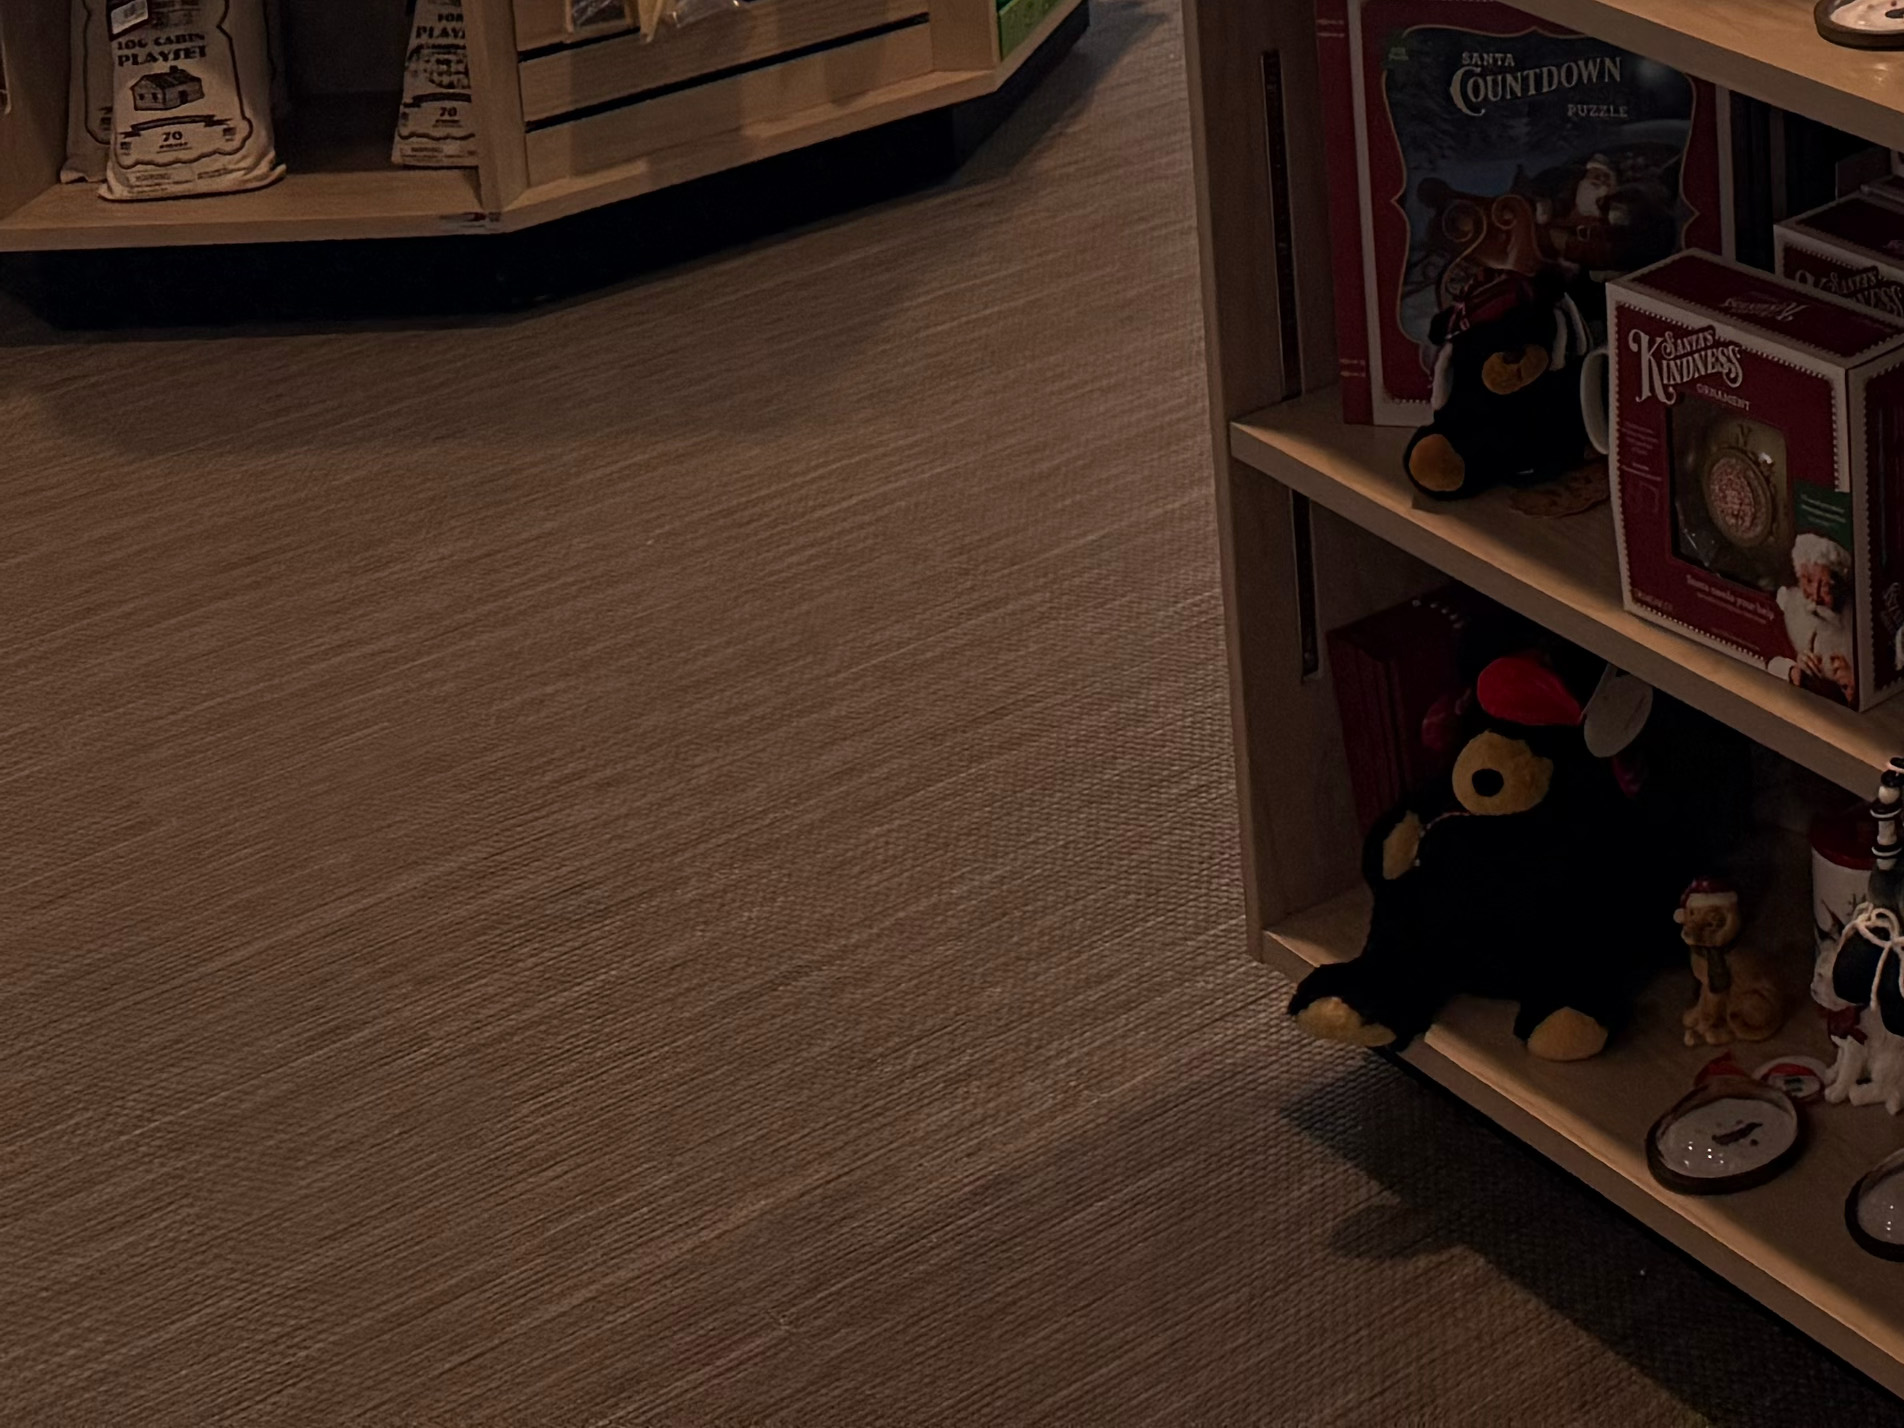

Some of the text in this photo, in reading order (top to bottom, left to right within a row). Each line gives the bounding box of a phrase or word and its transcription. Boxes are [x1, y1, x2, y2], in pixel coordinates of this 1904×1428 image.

[437, 13, 464, 22] FOR
[416, 25, 465, 39] PLAY
[117, 33, 206, 51] LOG CABIN
[117, 45, 207, 67] PLAYSET
[1461, 51, 1516, 67] SANTA
[1449, 57, 1622, 117] COUNTDOWN
[440, 107, 458, 117] 70
[1567, 104, 1629, 119] PUZZLE
[162, 131, 183, 142] 70
[1662, 326, 1716, 360] SANTA'S
[1627, 328, 1744, 405] KINDNESS
[1695, 384, 1751, 411] ORNAMENT
[1756, 601, 1776, 622] help
